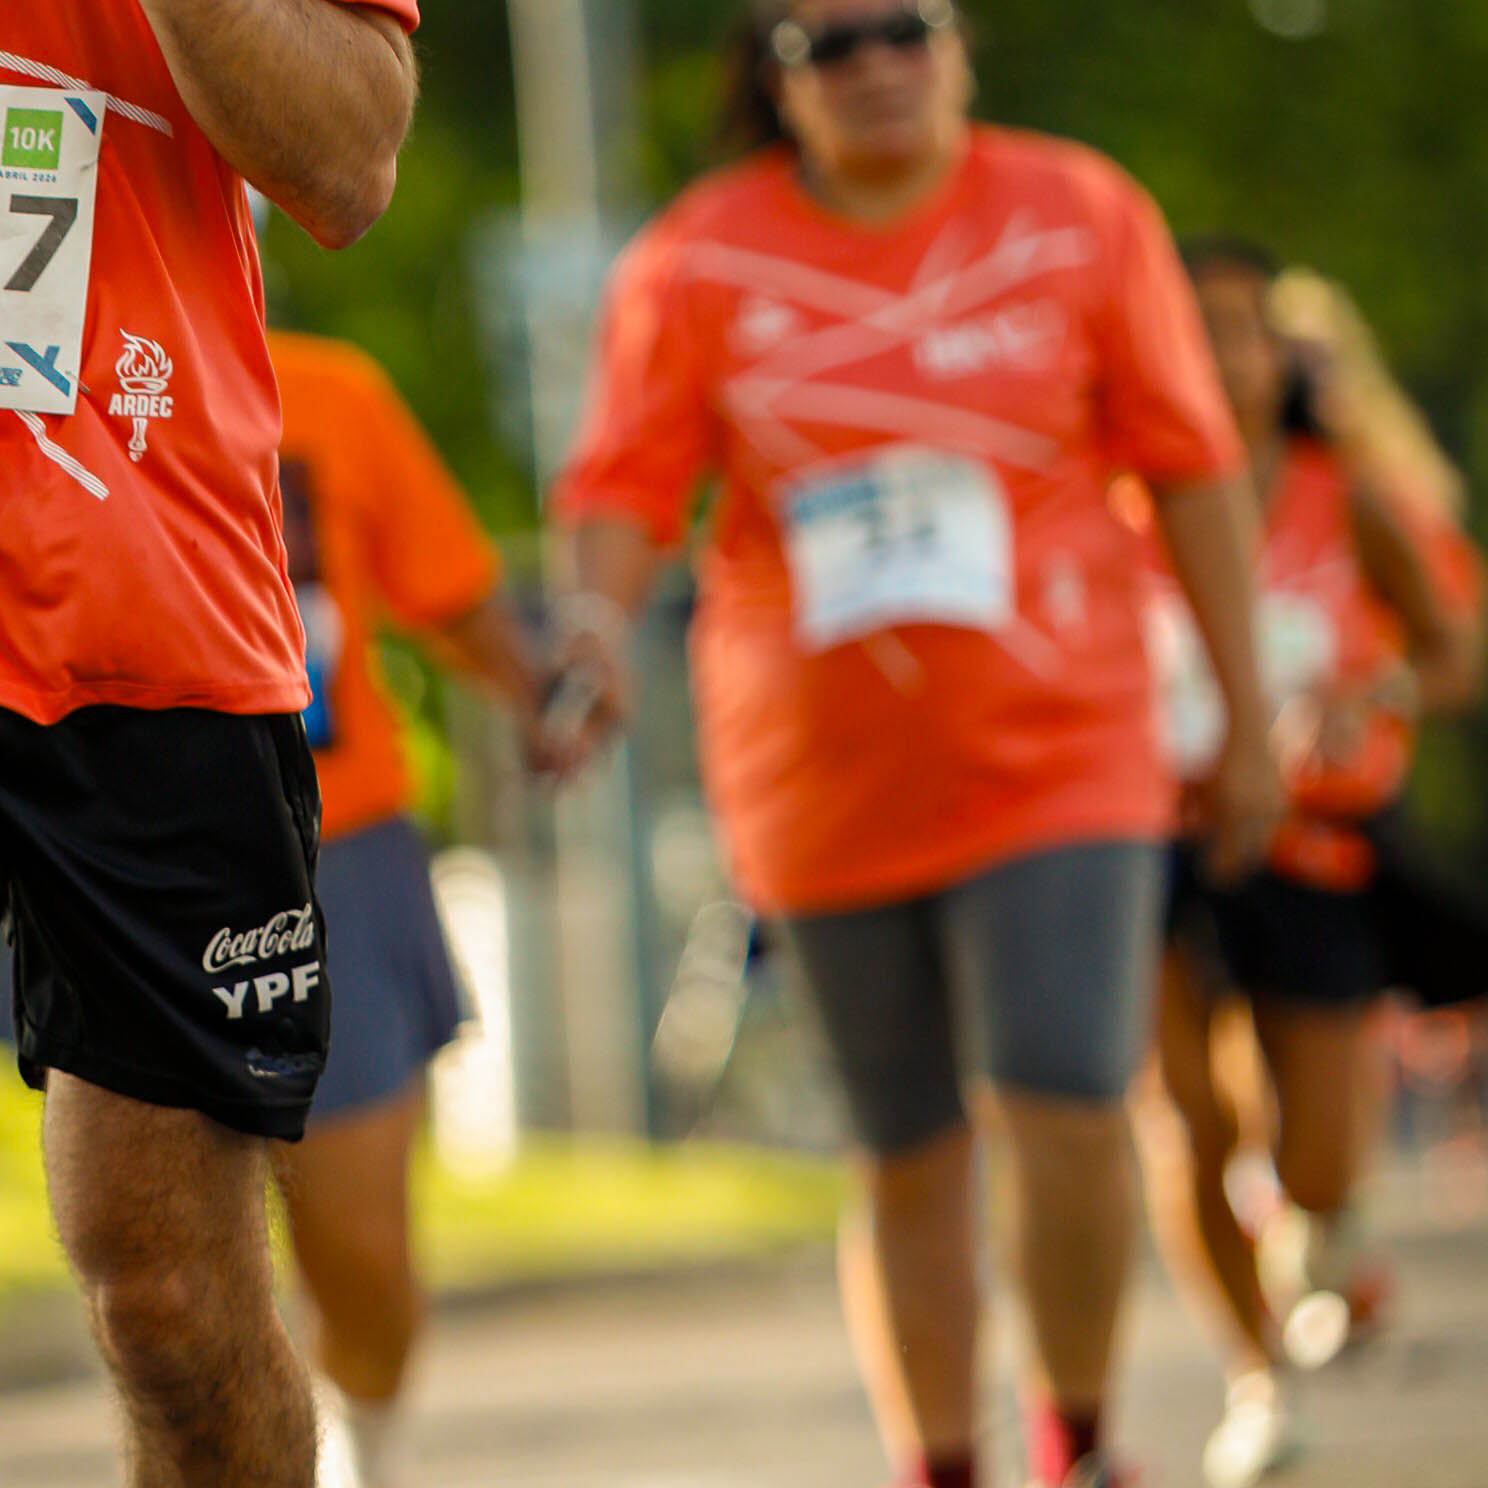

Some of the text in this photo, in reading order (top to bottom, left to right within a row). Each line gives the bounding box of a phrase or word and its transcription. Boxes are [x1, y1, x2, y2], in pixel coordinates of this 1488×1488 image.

[10, 126, 55, 152] 10K
[108, 393, 174, 418] ARDEC
[212, 961, 320, 1019] YPF
